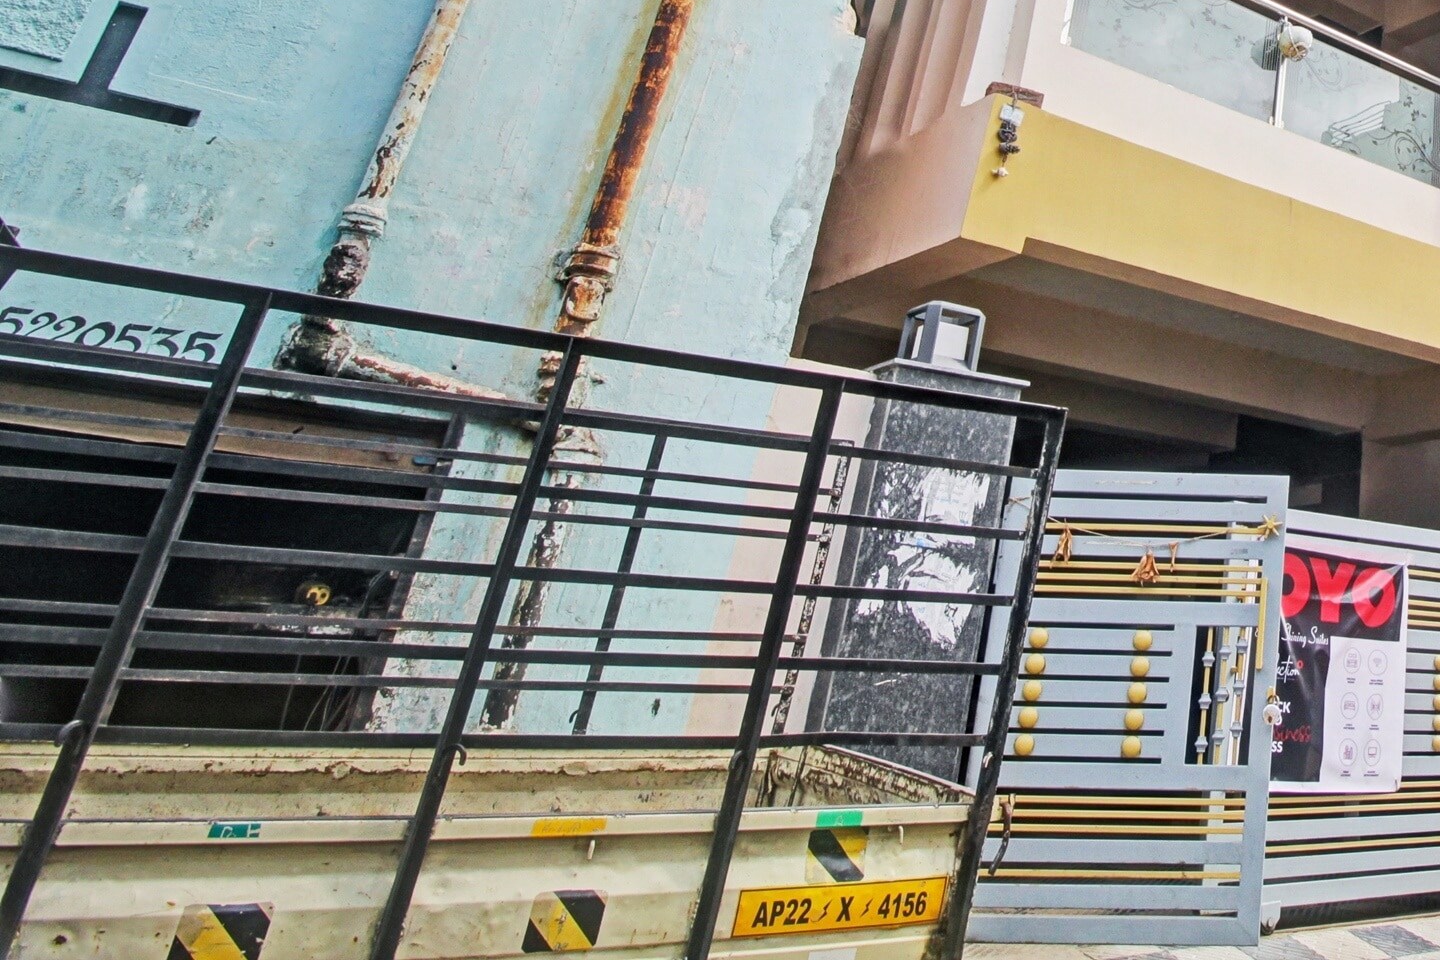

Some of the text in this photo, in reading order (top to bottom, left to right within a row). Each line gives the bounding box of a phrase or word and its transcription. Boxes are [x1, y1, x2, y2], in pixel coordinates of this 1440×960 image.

[1281, 552, 1396, 628] OYO
[751, 898, 812, 929] AP22
[877, 891, 928, 919] 4156
